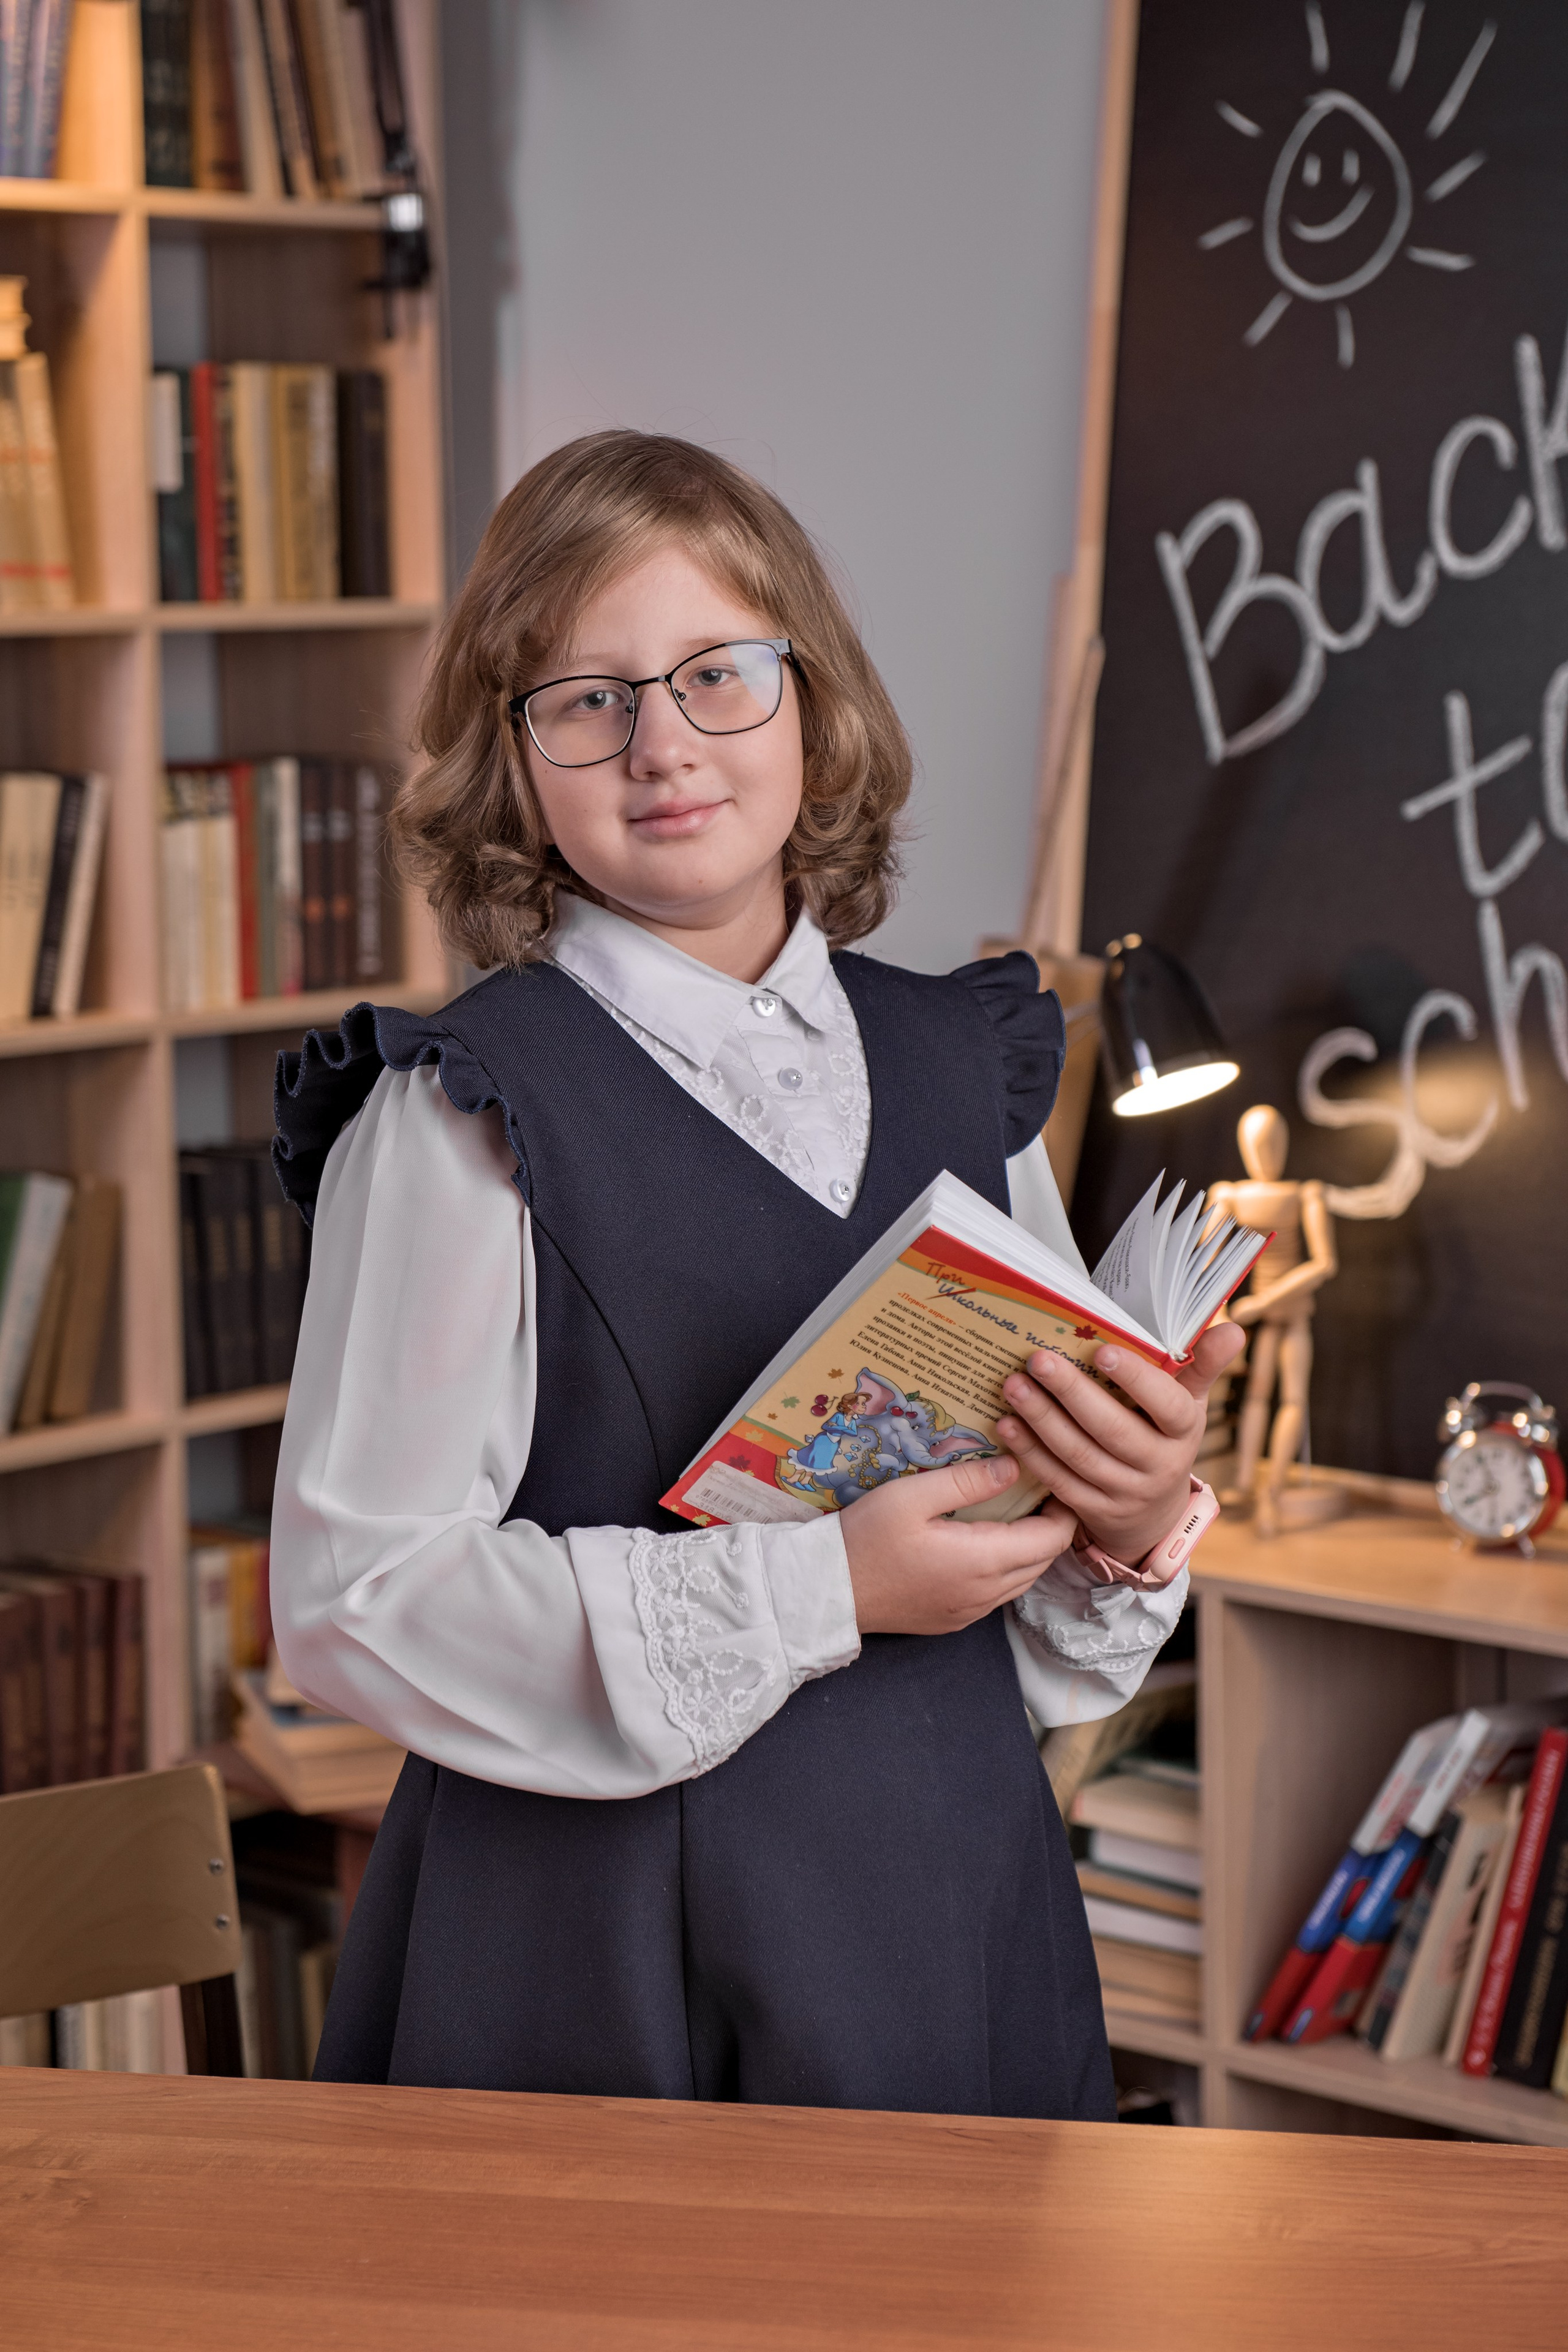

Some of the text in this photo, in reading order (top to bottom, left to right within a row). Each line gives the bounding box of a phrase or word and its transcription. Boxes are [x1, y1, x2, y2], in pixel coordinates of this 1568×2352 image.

[925, 1262, 965, 1284] При
[864, 1324, 1001, 1401] литературных премий Сергей Махотин,
[873, 1316, 907, 1336] прозаики
[912, 1337, 936, 1354] поэты,
[938, 1351, 972, 1371] пишущие
[971, 1370, 986, 1379] для
[886, 1311, 907, 1324] дома.
[908, 1322, 936, 1340] Авторы
[936, 1337, 954, 1349] этой
[953, 1347, 983, 1365] весёлой
[982, 1363, 1004, 1376] книги
[889, 1300, 926, 1322] проделках
[926, 1320, 973, 1348] современных
[973, 1345, 1013, 1370] мальчишек
[897, 1292, 928, 1310] «Первое
[928, 1308, 957, 1325] апреля»
[965, 1329, 995, 1347] сборник
[995, 1344, 1027, 1365] смешных
[849, 1338, 872, 1354] Юлия
[872, 1351, 910, 1376] Кузнецова,
[911, 1373, 930, 1386] Анна
[930, 1382, 965, 1406] Игнатова,
[966, 1403, 1001, 1424] Дмитрий
[857, 1330, 880, 1346] Елена
[880, 1343, 905, 1362] Габова,
[907, 1359, 927, 1371] Анна
[926, 1368, 971, 1396] Никольская,
[972, 1393, 1008, 1418] Владимир
[696, 1502, 715, 1513] 318
